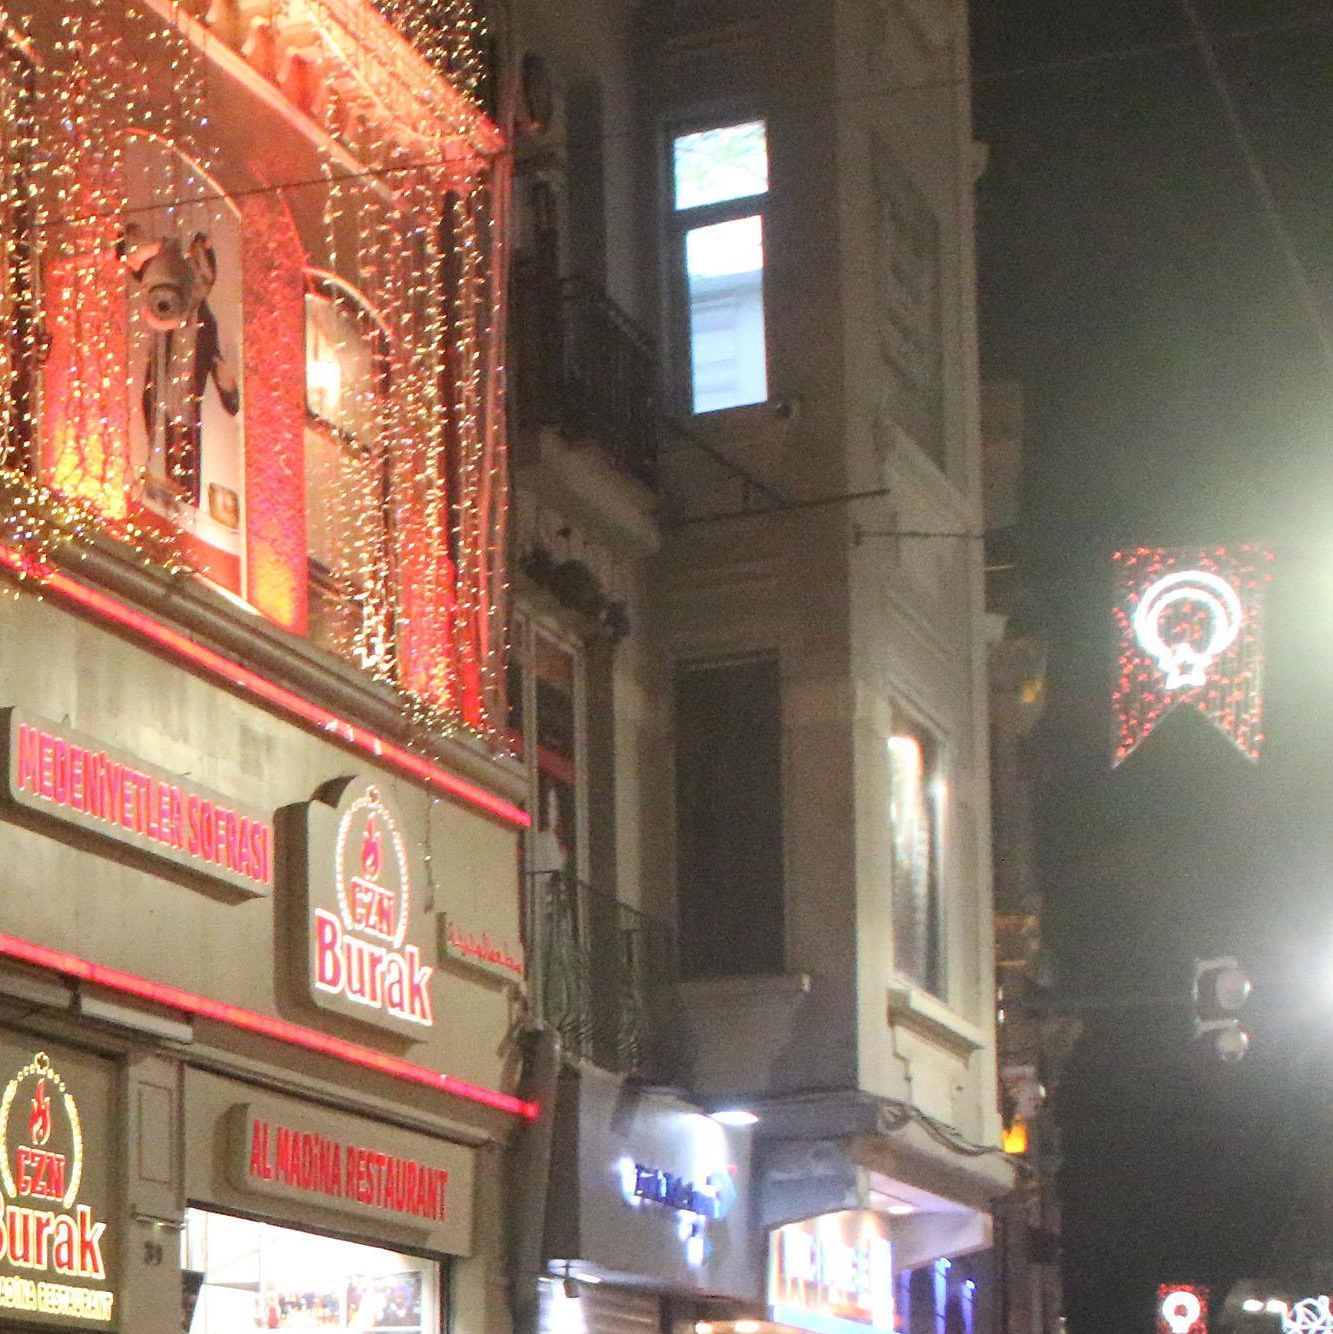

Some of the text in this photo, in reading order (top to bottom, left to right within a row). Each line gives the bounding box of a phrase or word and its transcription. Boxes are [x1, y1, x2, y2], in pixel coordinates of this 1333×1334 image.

[186, 792, 273, 885] SOFRASI
[314, 907, 434, 1027] Burak
[250, 1119, 273, 1181] AL
[344, 1145, 449, 1222] RESTAURANT
